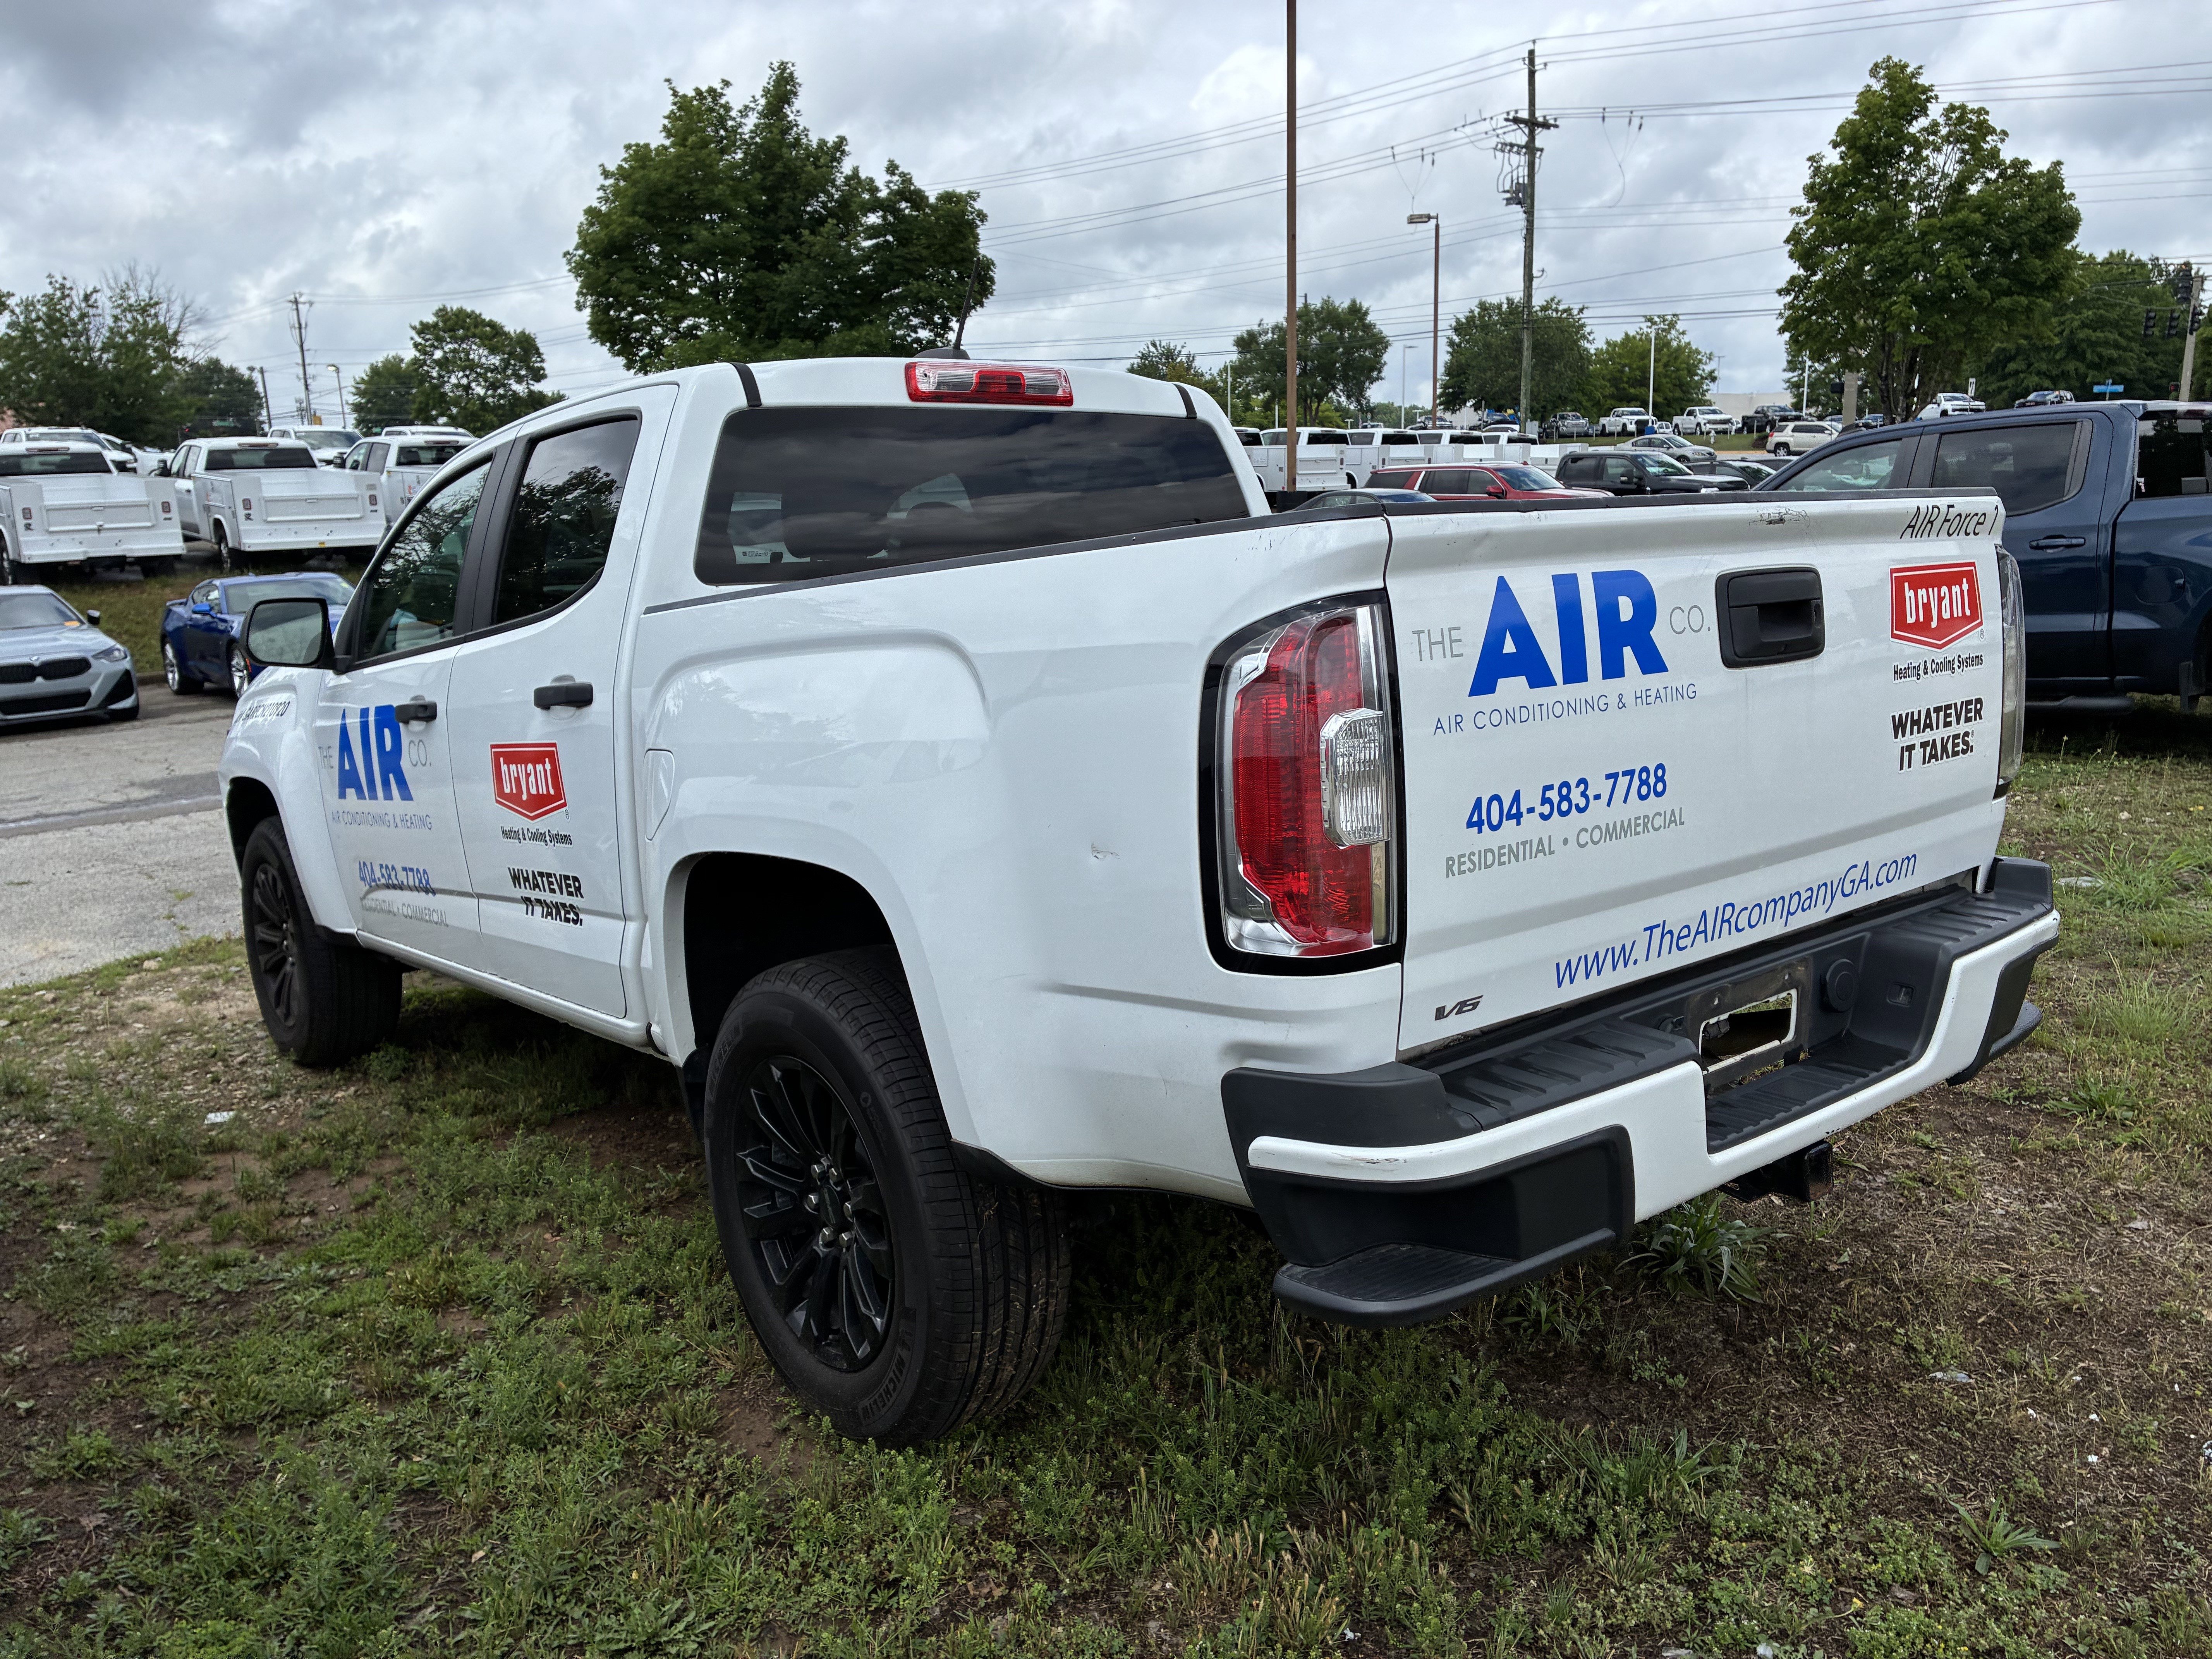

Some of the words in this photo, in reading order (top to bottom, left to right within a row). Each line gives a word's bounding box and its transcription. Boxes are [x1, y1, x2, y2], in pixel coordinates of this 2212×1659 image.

[1900, 505, 1941, 539] AIR
[1937, 505, 1987, 537] Force
[1989, 505, 1999, 536] 1
[1904, 578, 1971, 629] bryant
[1412, 627, 1463, 661] THE
[1468, 570, 1669, 697] AIR
[1669, 605, 1711, 635] CO.
[1894, 661, 1921, 681] Heating
[1923, 661, 1929, 675] &
[1931, 655, 1955, 675] Cooling
[1957, 653, 1983, 673] Systems
[1433, 714, 1464, 736] AIR
[1474, 694, 1609, 730] CONDITIONING
[1618, 694, 1627, 709] &
[1635, 684, 1697, 708] HEATING
[1891, 697, 1983, 740] WHATEVER
[318, 745, 333, 769] THE
[338, 704, 414, 801] AIR
[409, 739, 432, 767] CO.
[1899, 743, 1916, 771] IT
[500, 757, 555, 801] bryant
[1466, 763, 1667, 834] 404-583-7788
[342, 811, 390, 828] CONDITIONING
[392, 814, 398, 828] &
[400, 814, 432, 830] HEATING
[501, 826, 522, 844] Heating
[522, 827, 527, 841] &
[527, 828, 548, 846] Cooling
[548, 829, 572, 847] Systems
[1446, 835, 1555, 878] RESIDENTIAL
[1576, 807, 1685, 848] COMMERCIAL
[359, 860, 436, 897] 404-583-7788
[507, 867, 584, 898] WHATEVER
[361, 897, 396, 916] RESIDENTIAL
[402, 902, 448, 927] COMMERCIAL
[520, 895, 534, 917] IT
[1555, 852, 1918, 989] www.TheAIRcompanyGA.com
[1434, 994, 1484, 1021] V6
[860, 1352, 907, 1421] MICHELIN
